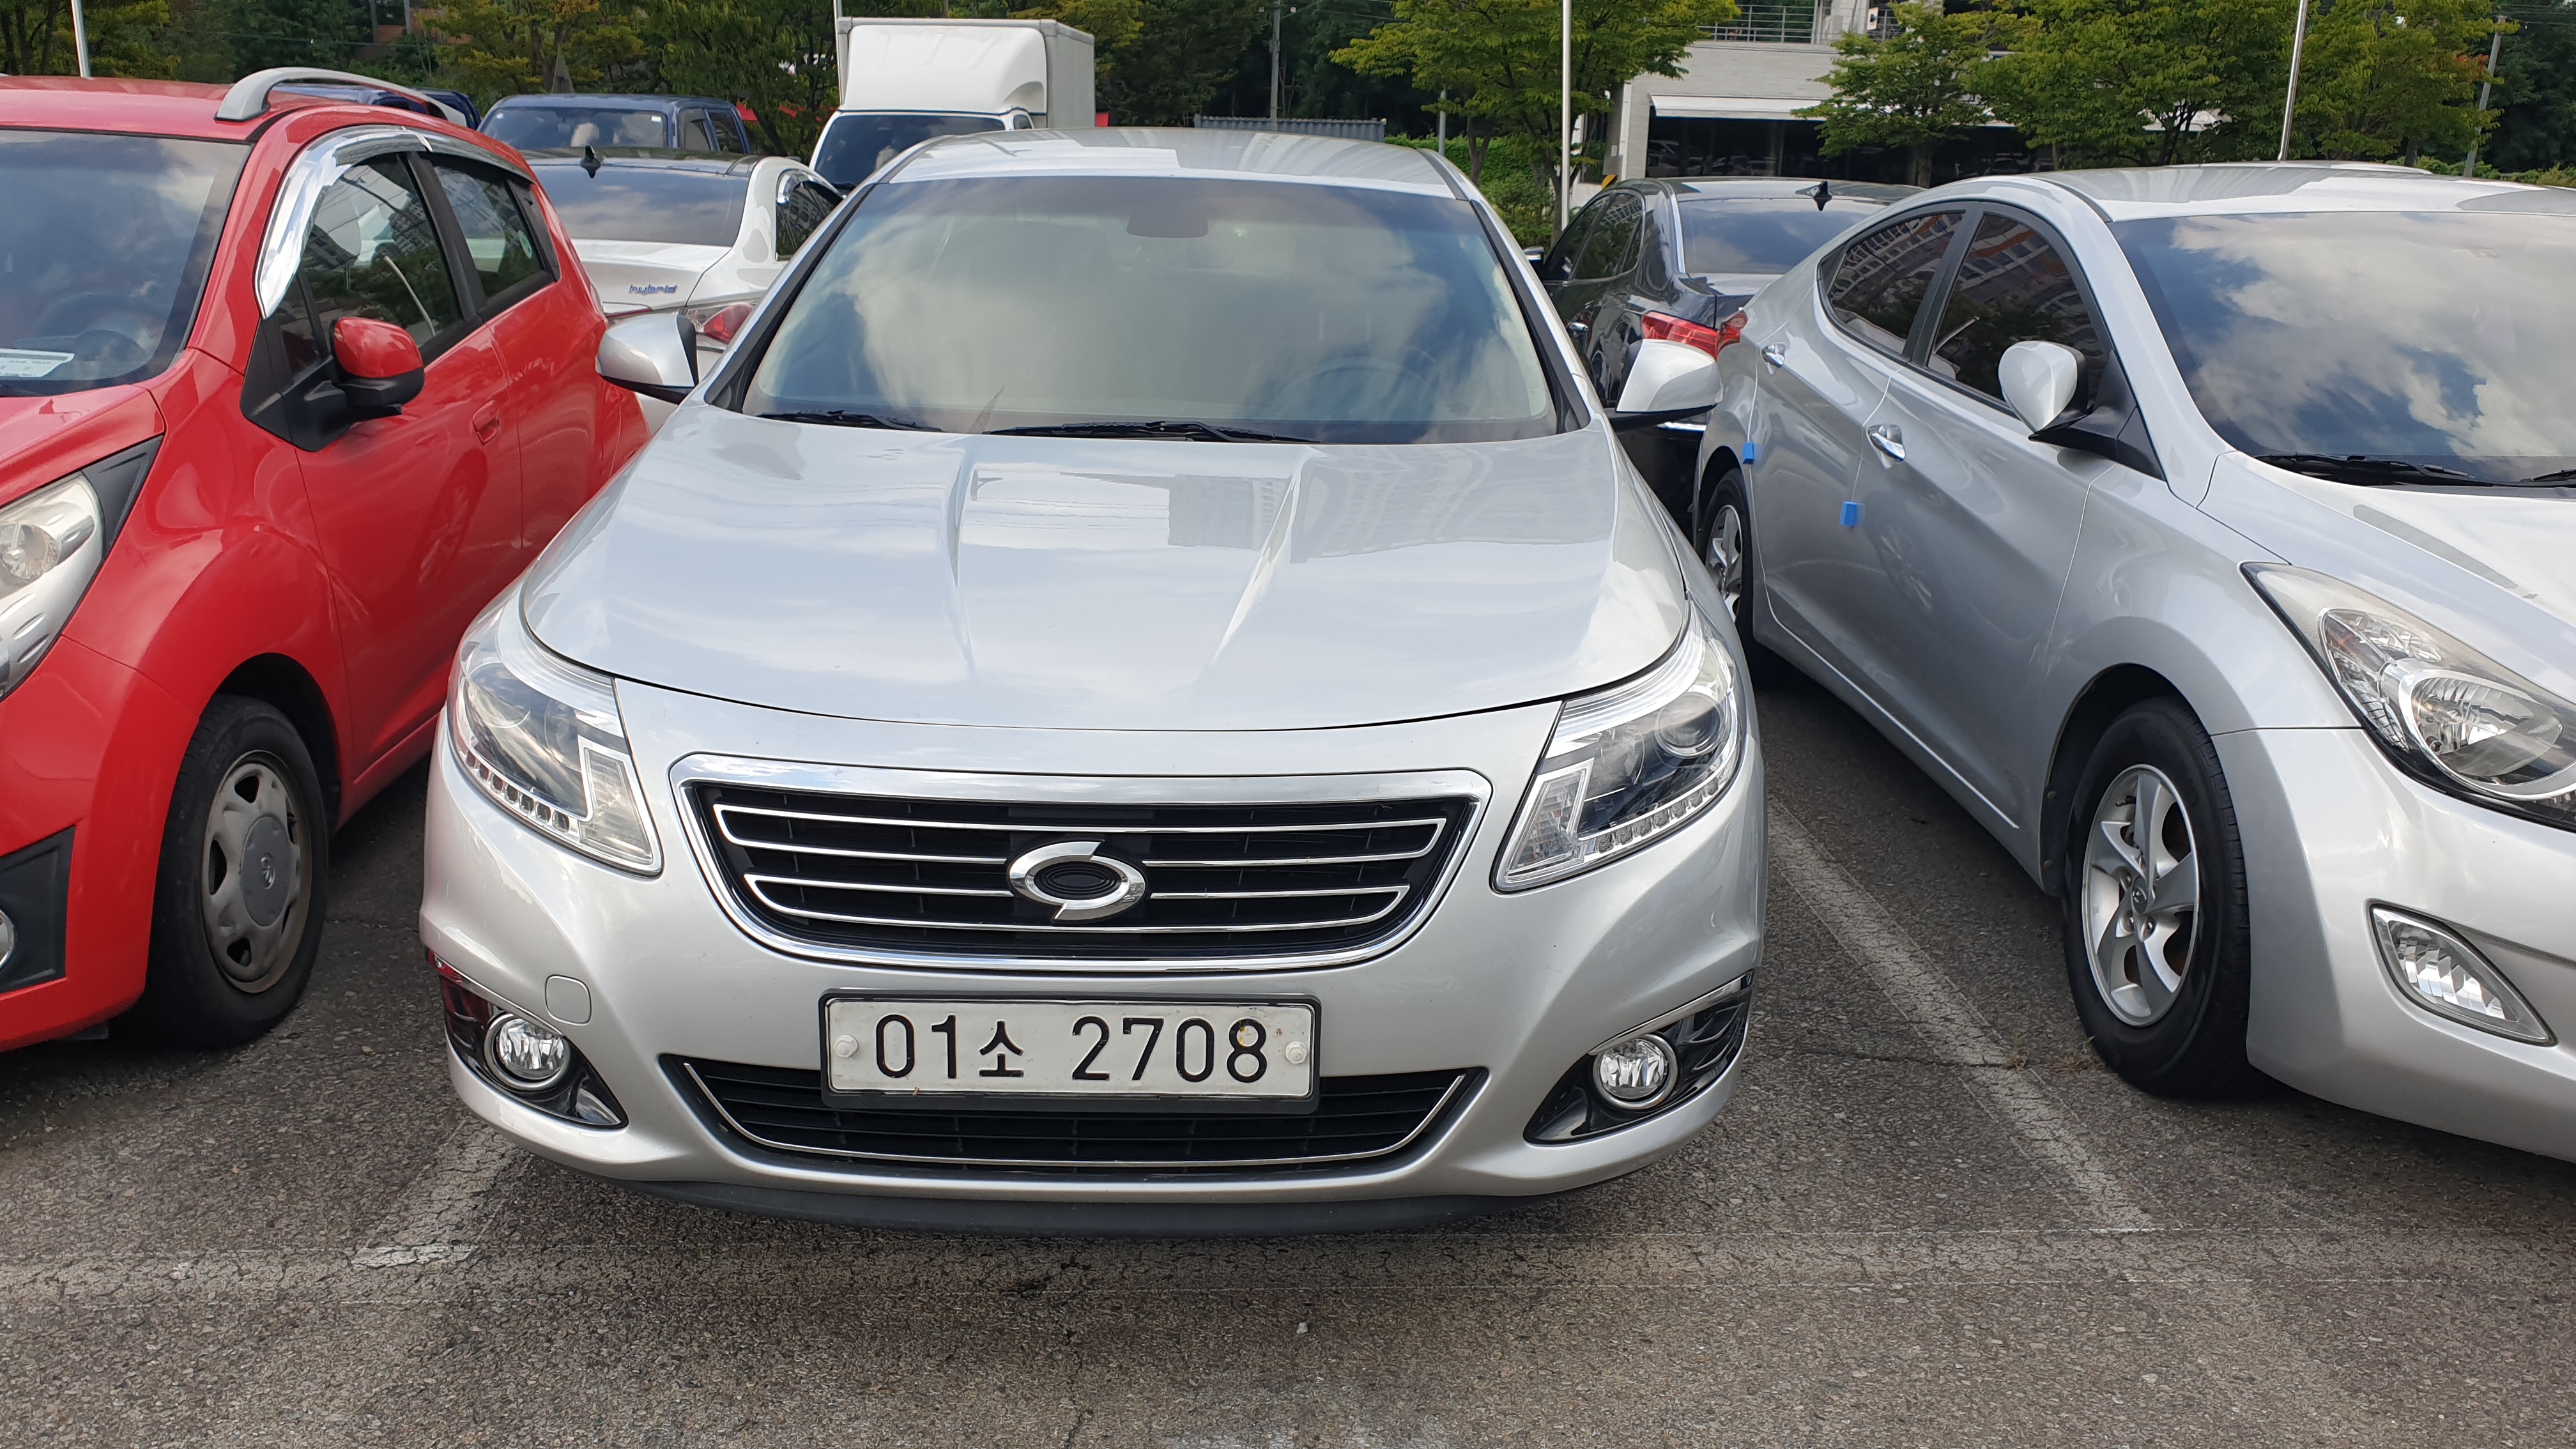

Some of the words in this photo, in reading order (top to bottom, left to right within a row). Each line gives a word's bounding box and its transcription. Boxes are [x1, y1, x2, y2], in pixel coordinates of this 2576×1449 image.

[629, 284, 678, 294] hybrid
[875, 1013, 1024, 1080] 01소
[1071, 1015, 1268, 1084] 2708
